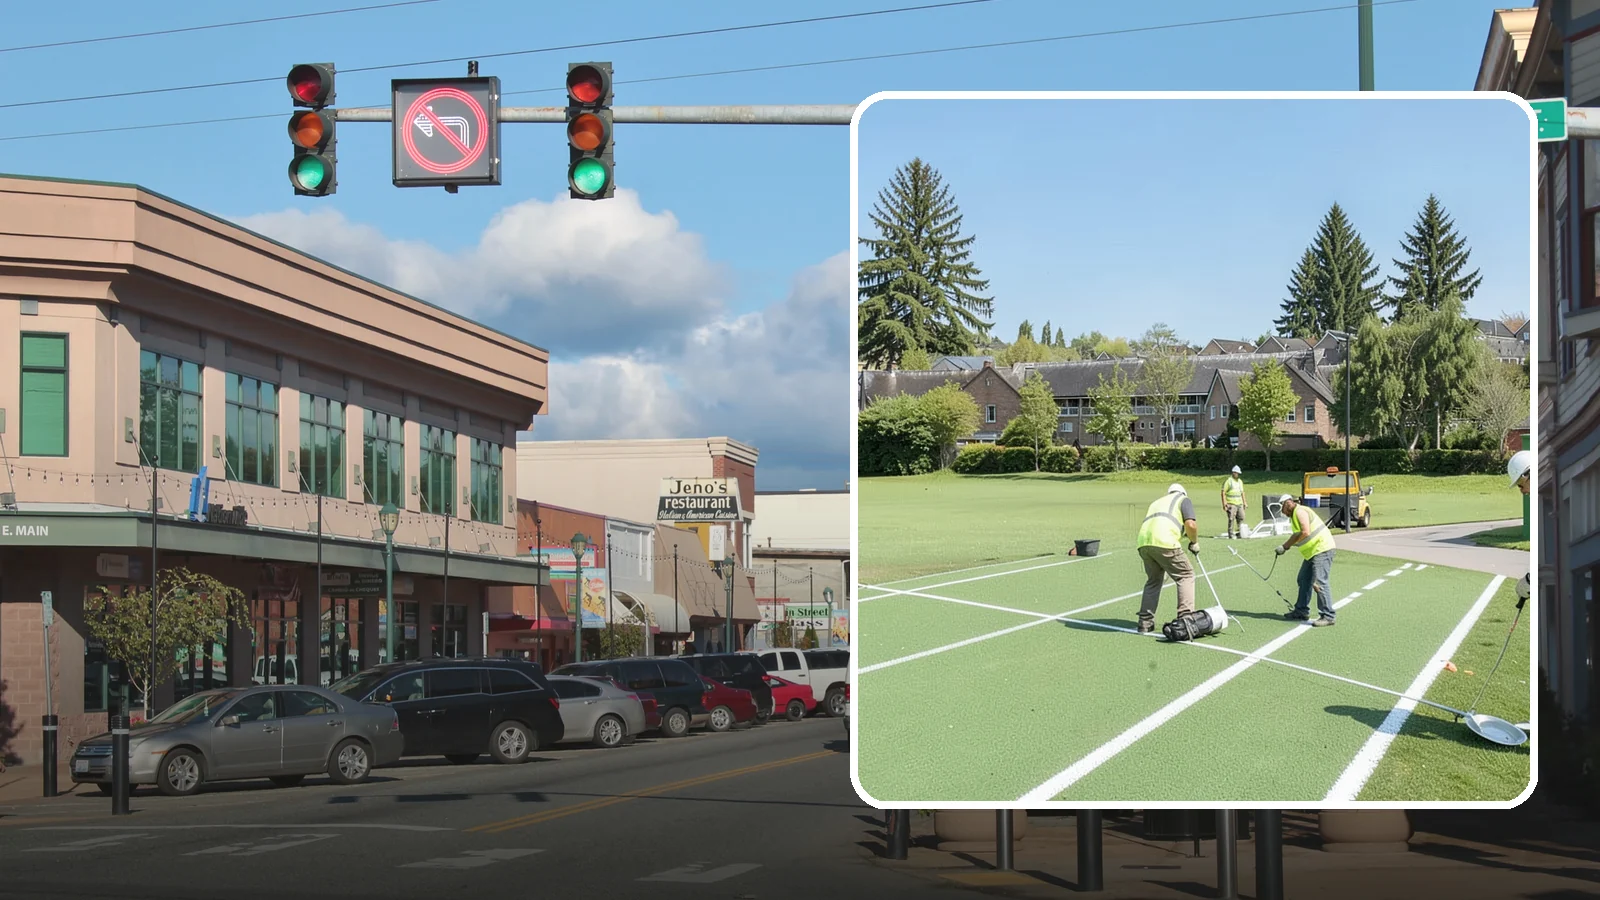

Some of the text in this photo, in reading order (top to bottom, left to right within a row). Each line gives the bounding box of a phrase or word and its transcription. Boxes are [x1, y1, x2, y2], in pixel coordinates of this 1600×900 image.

[669, 480, 727, 494] Jeno's
[665, 496, 731, 509] restaurant
[714, 509, 737, 519] Cuisine
[2, 525, 49, 536] E. MAIN
[797, 607, 828, 617] Street
[790, 619, 824, 627] lass
